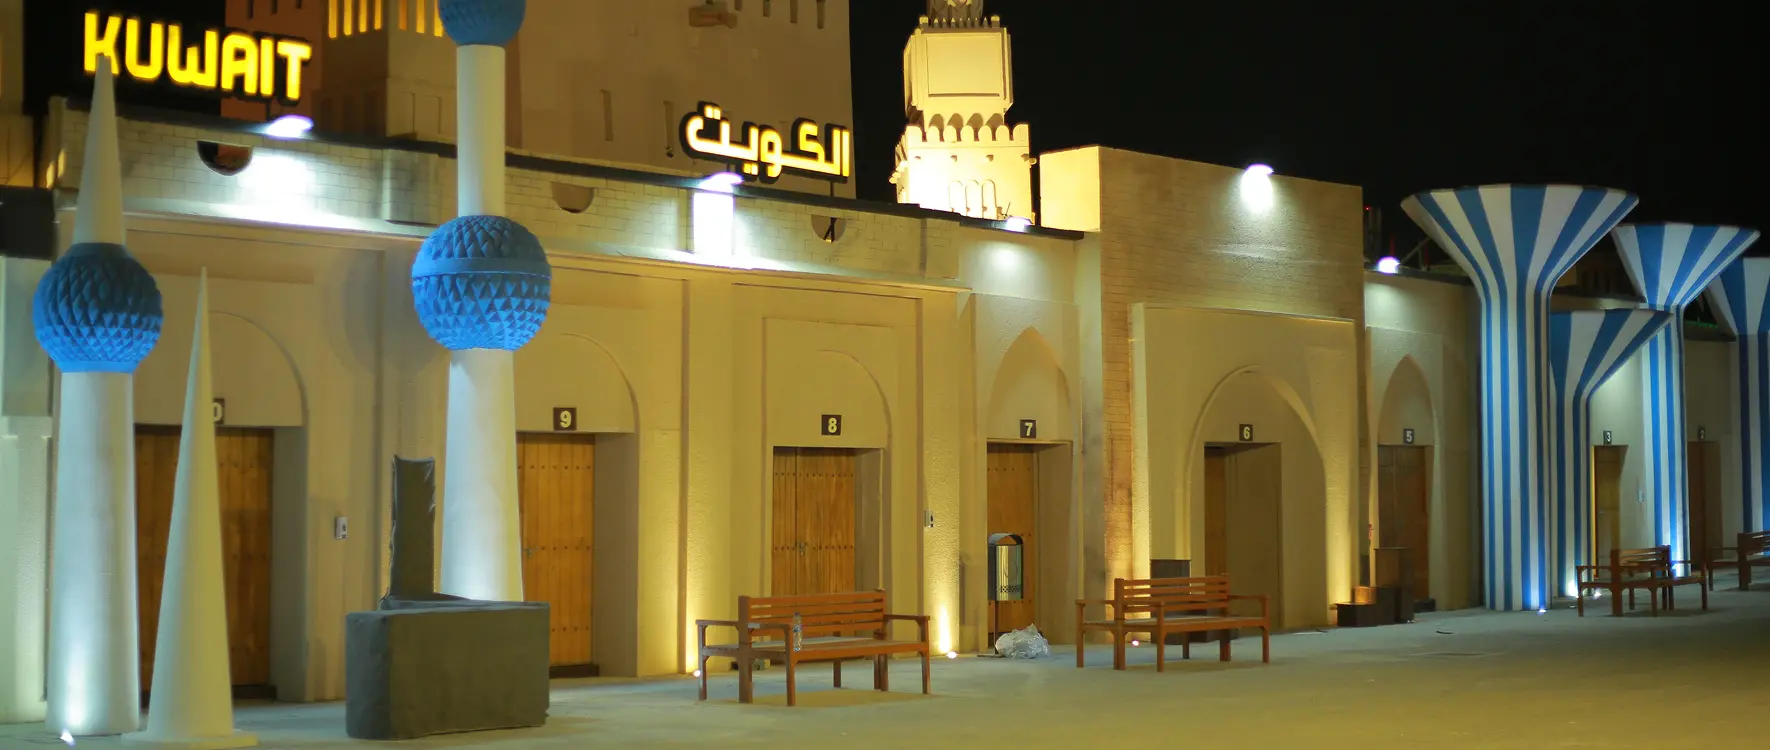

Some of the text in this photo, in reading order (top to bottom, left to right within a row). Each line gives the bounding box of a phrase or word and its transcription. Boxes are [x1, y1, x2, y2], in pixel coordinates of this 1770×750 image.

[84, 12, 311, 100] KUWAIT
[686, 104, 850, 178] الكويت
[559, 410, 572, 428] 9
[828, 417, 837, 433] 8
[1024, 422, 1033, 436] 7
[1243, 426, 1250, 440] 6
[1406, 430, 1412, 442] 5
[1606, 431, 1611, 442] 3
